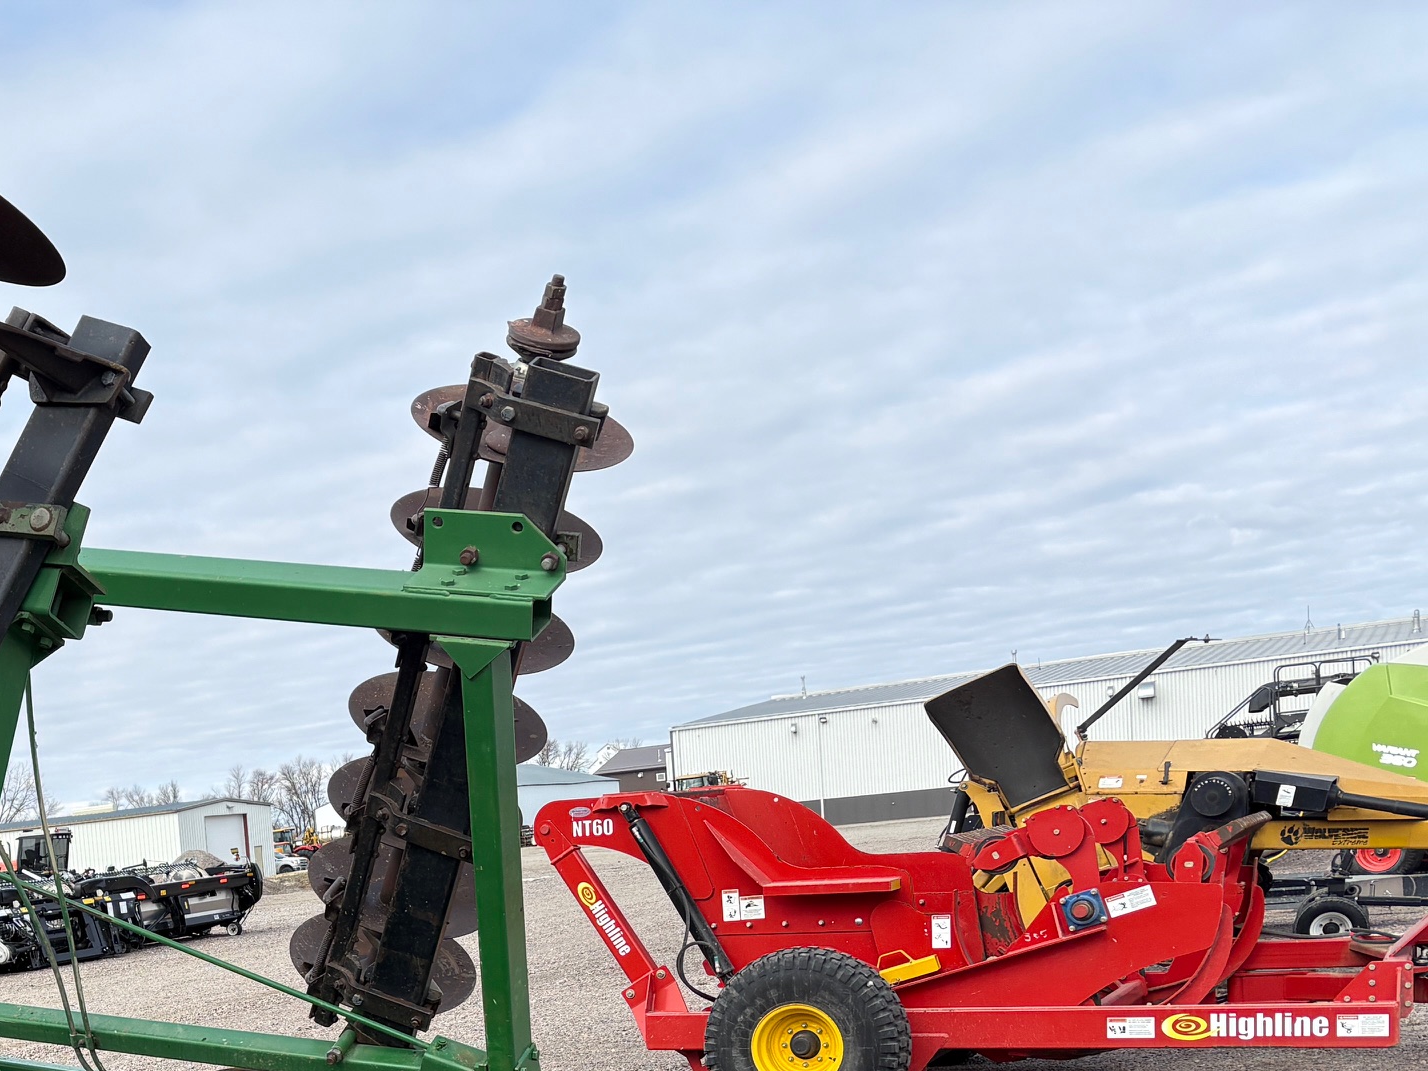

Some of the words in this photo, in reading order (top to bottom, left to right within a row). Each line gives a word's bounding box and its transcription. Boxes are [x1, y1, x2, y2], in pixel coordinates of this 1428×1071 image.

[572, 818, 614, 838] NT60
[589, 900, 631, 956] Highline
[1209, 1012, 1330, 1041] Highline
